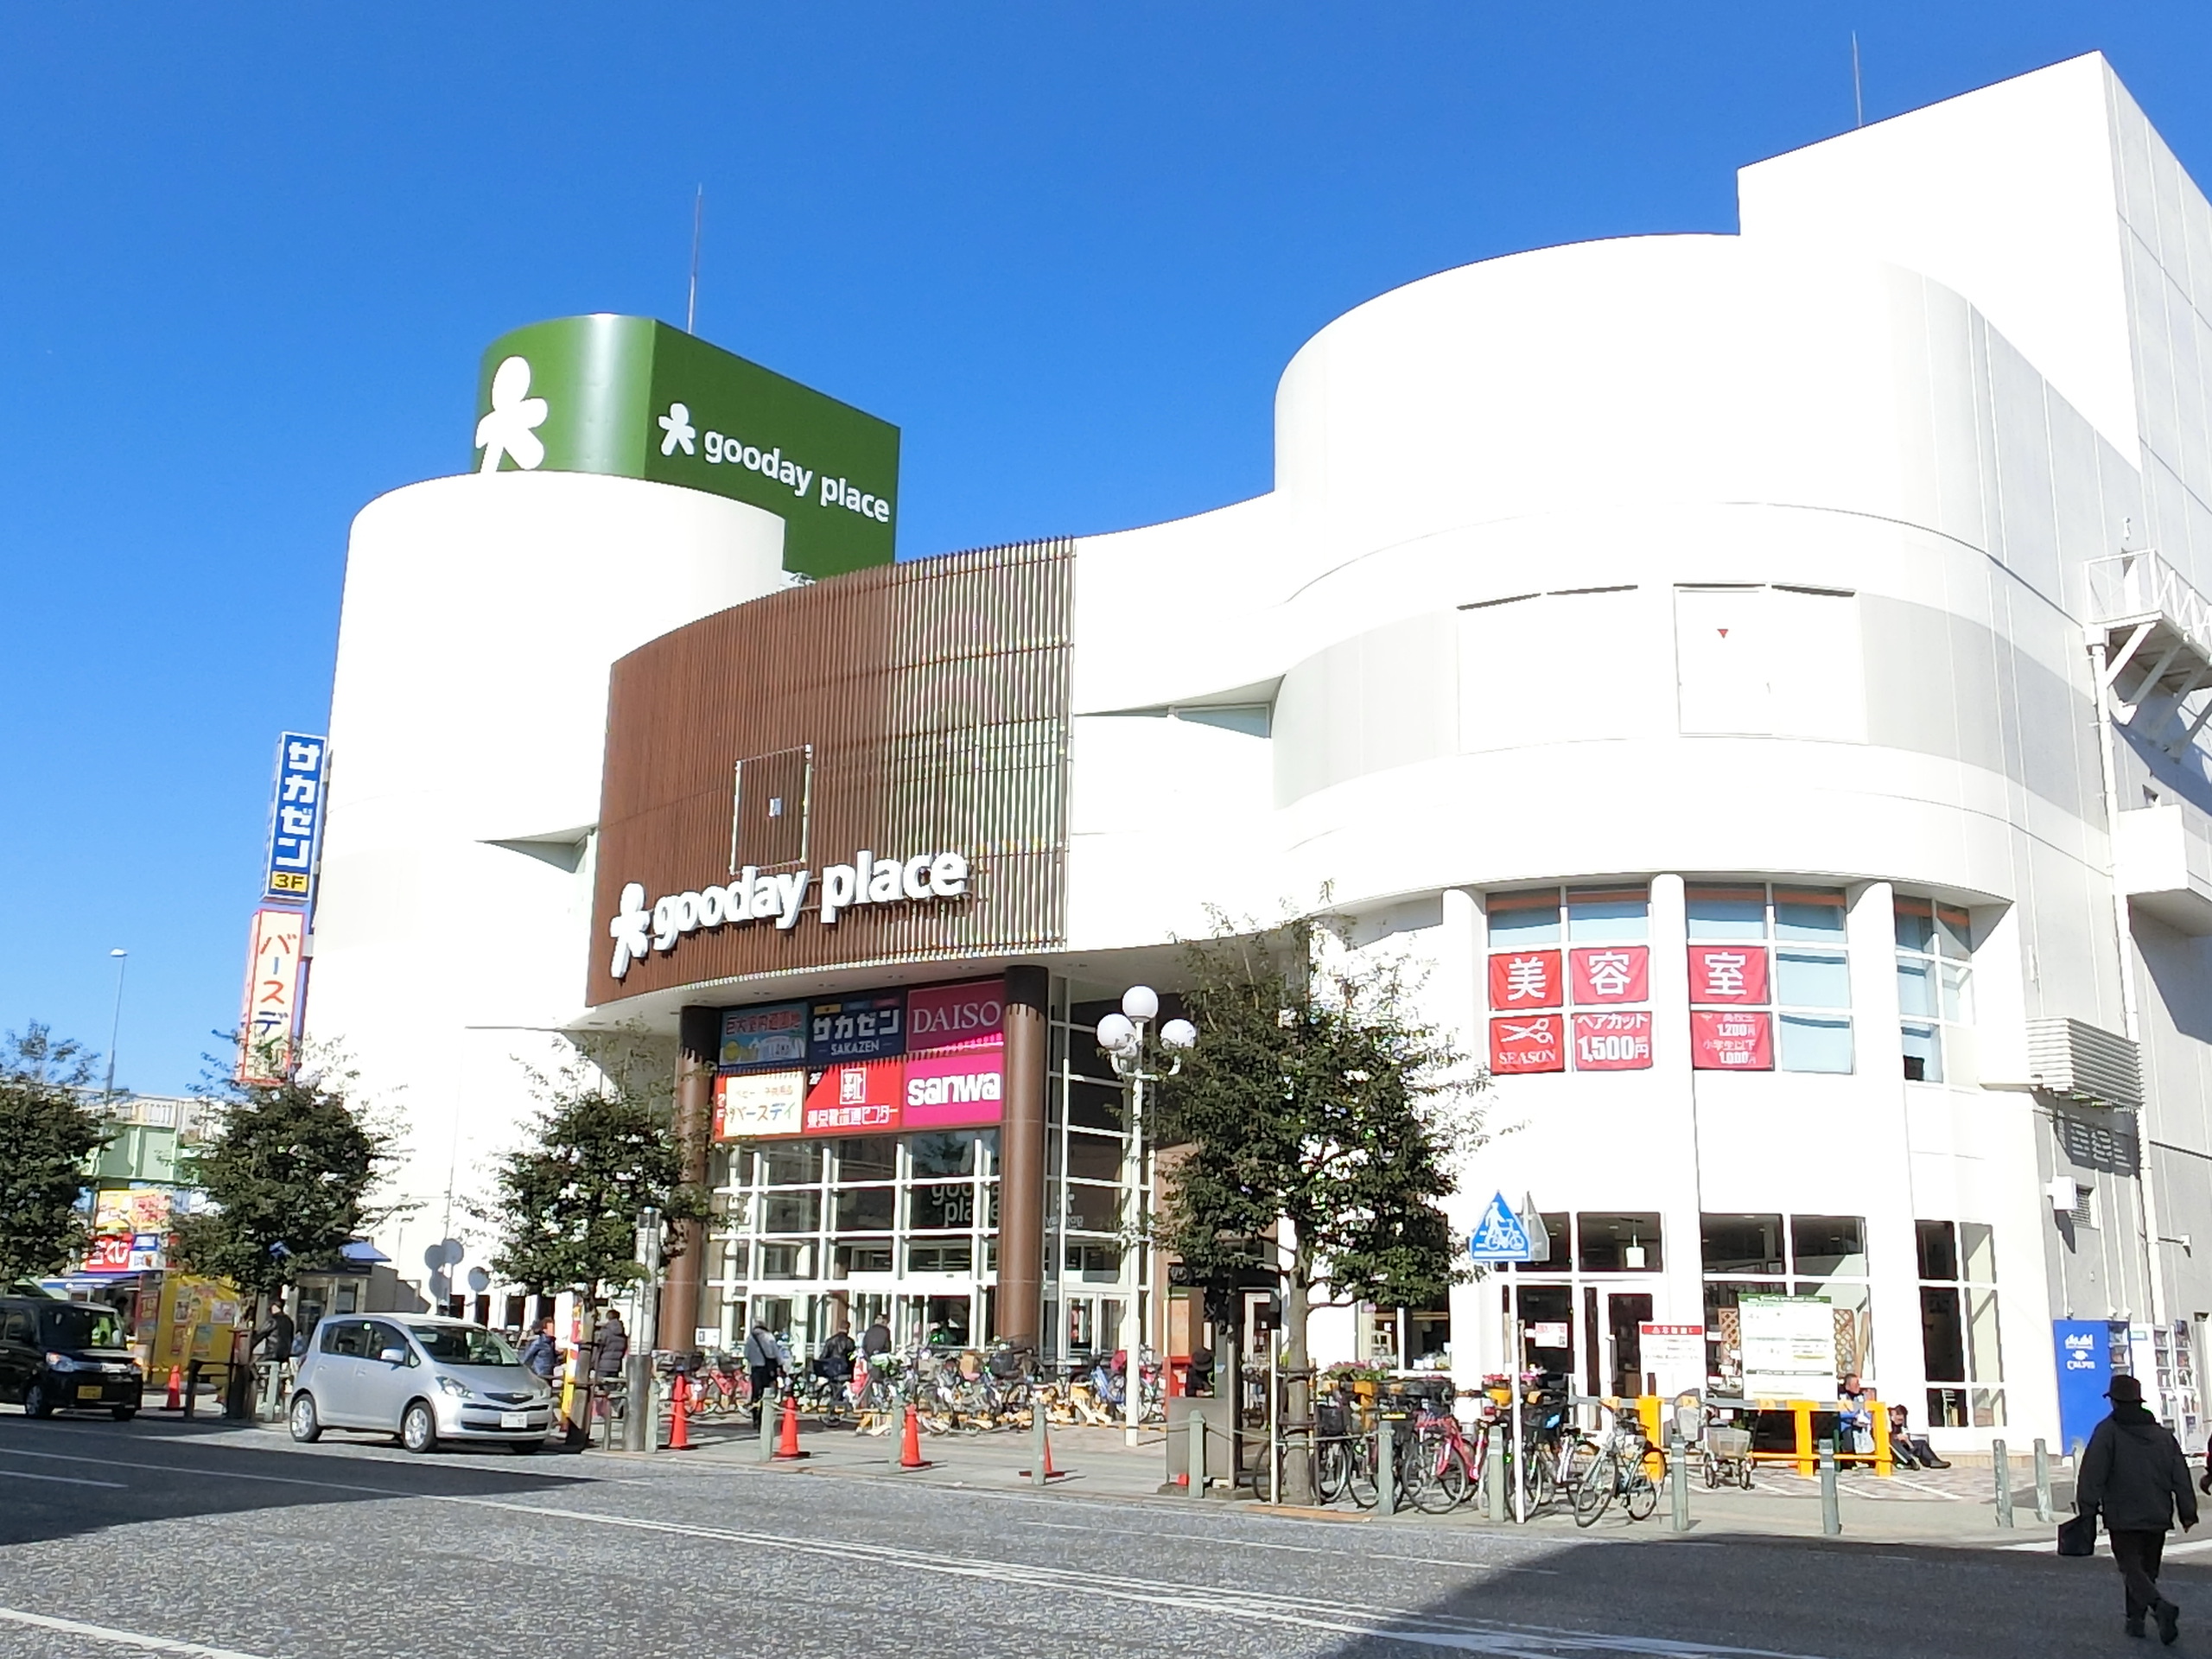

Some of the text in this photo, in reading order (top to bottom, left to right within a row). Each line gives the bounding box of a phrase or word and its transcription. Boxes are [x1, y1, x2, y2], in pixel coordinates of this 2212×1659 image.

[704, 430, 890, 523] gooday place
[276, 741, 321, 868] サカゼン
[275, 874, 304, 889] 3F
[653, 850, 968, 950] gooday place
[812, 1009, 899, 1042] サカゼン
[912, 1001, 1001, 1033] DAISO
[1577, 1014, 1649, 1030] ヘアカット
[830, 1039, 880, 1056] SAKAZEN
[1497, 1049, 1555, 1065] SEASON
[907, 1072, 1001, 1106] sanwa
